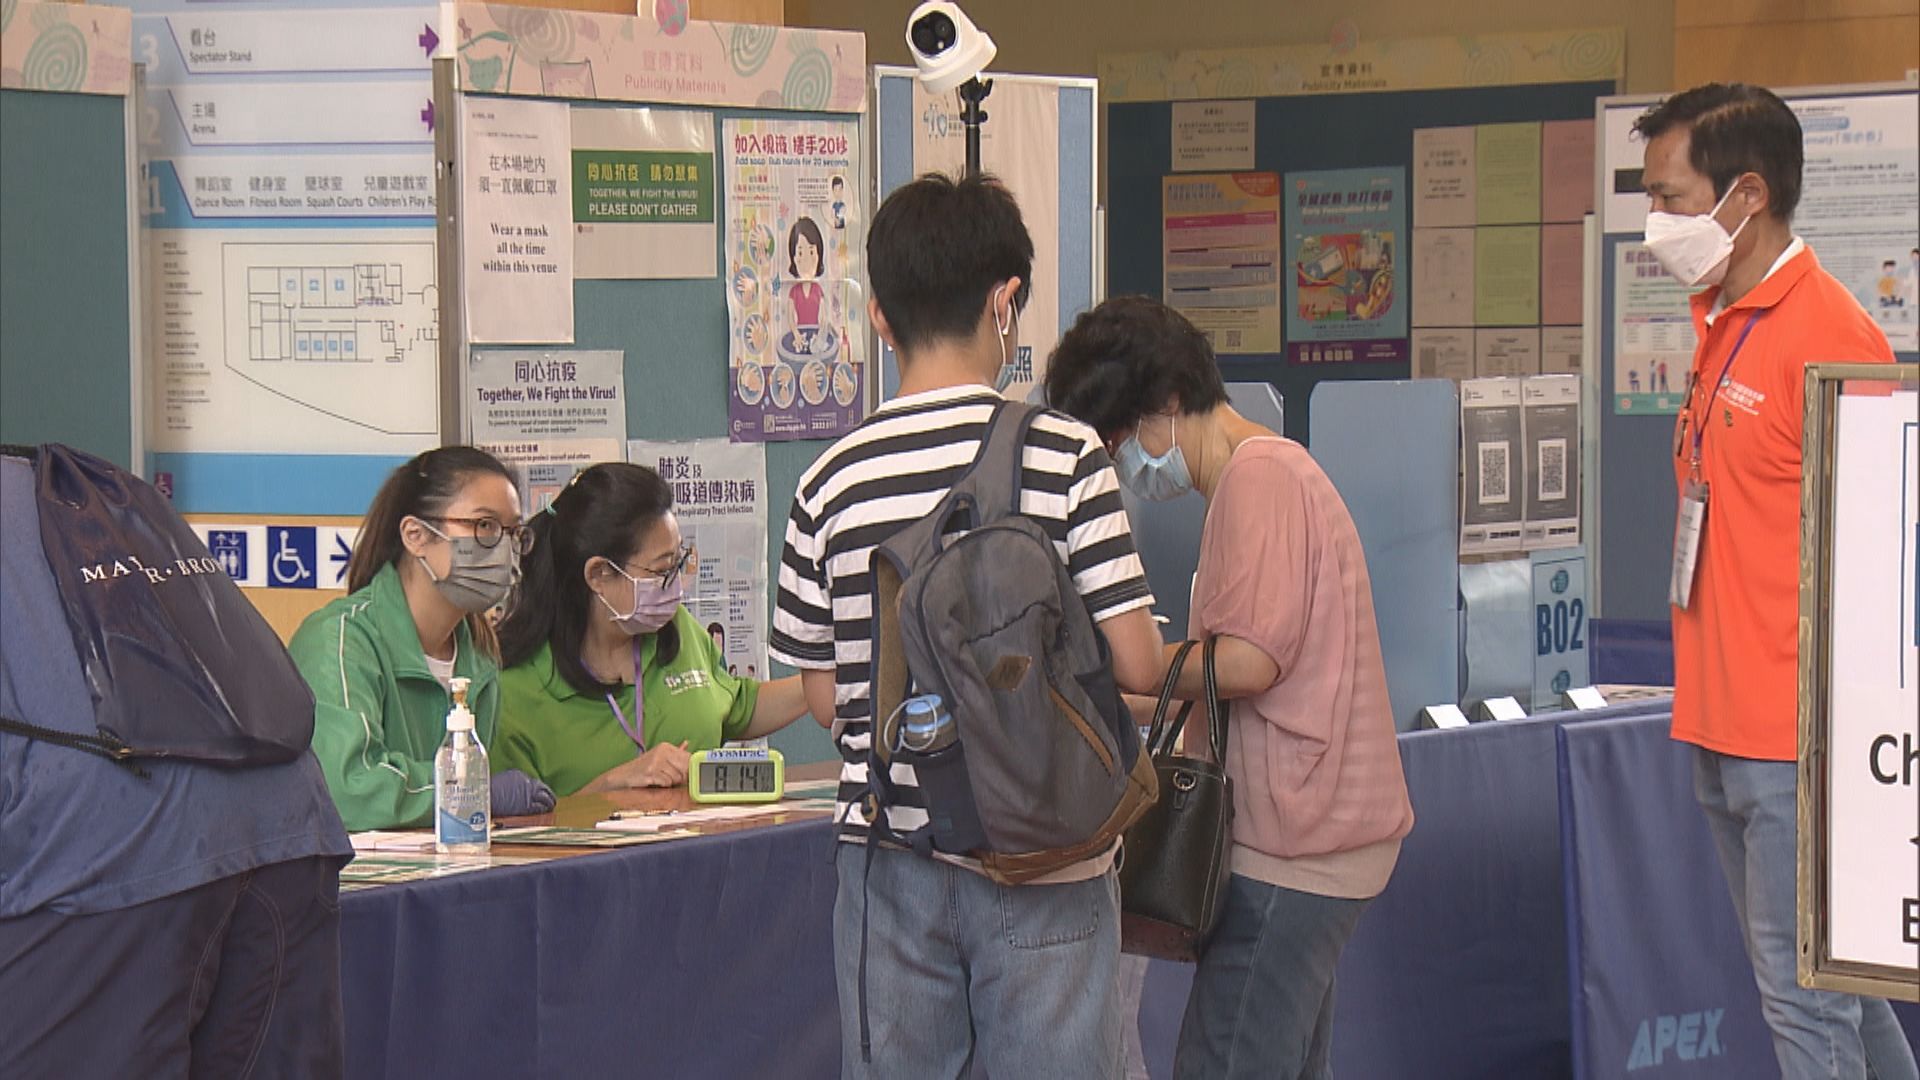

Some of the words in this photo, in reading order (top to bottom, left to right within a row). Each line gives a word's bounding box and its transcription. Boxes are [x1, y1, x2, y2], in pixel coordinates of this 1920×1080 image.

[190, 51, 227, 63] Spectator
[229, 50, 252, 62] Stand
[624, 74, 672, 94] Publicity
[676, 77, 727, 95] Materials
[192, 102, 216, 118] 主場
[192, 124, 216, 133] Arena
[489, 154, 545, 173] 在本場地內
[588, 161, 639, 182] 同心抗疫
[249, 176, 287, 191] 健身室
[222, 196, 245, 207] Room
[249, 196, 278, 207] Fitness
[279, 196, 303, 207] Room
[307, 196, 336, 209] Squash
[337, 196, 363, 207] Courts
[368, 195, 407, 207] Children's
[408, 196, 426, 209] Play
[589, 202, 628, 216] PLEASE
[630, 203, 660, 216] DON'T
[661, 203, 698, 216] GATHER
[489, 221, 514, 235] Wear
[516, 226, 522, 235] a
[524, 224, 549, 237] mask
[497, 241, 508, 254] all
[510, 241, 524, 255] the
[526, 241, 546, 255] time
[483, 259, 511, 272] within
[513, 260, 529, 272] this
[531, 263, 558, 273] venue
[515, 360, 577, 383] 同心抗疫
[477, 386, 525, 404] Together,
[526, 386, 542, 400] We
[545, 386, 570, 403] Fight
[572, 385, 587, 400] the
[589, 385, 616, 400] Virus!
[671, 479, 755, 504] 吸道傳染病
[678, 506, 711, 518] Respiratory
[712, 505, 727, 515] Tract
[727, 504, 754, 514] Infection
[1536, 598, 1584, 656] B02
[1627, 1008, 1725, 1073] APEX
